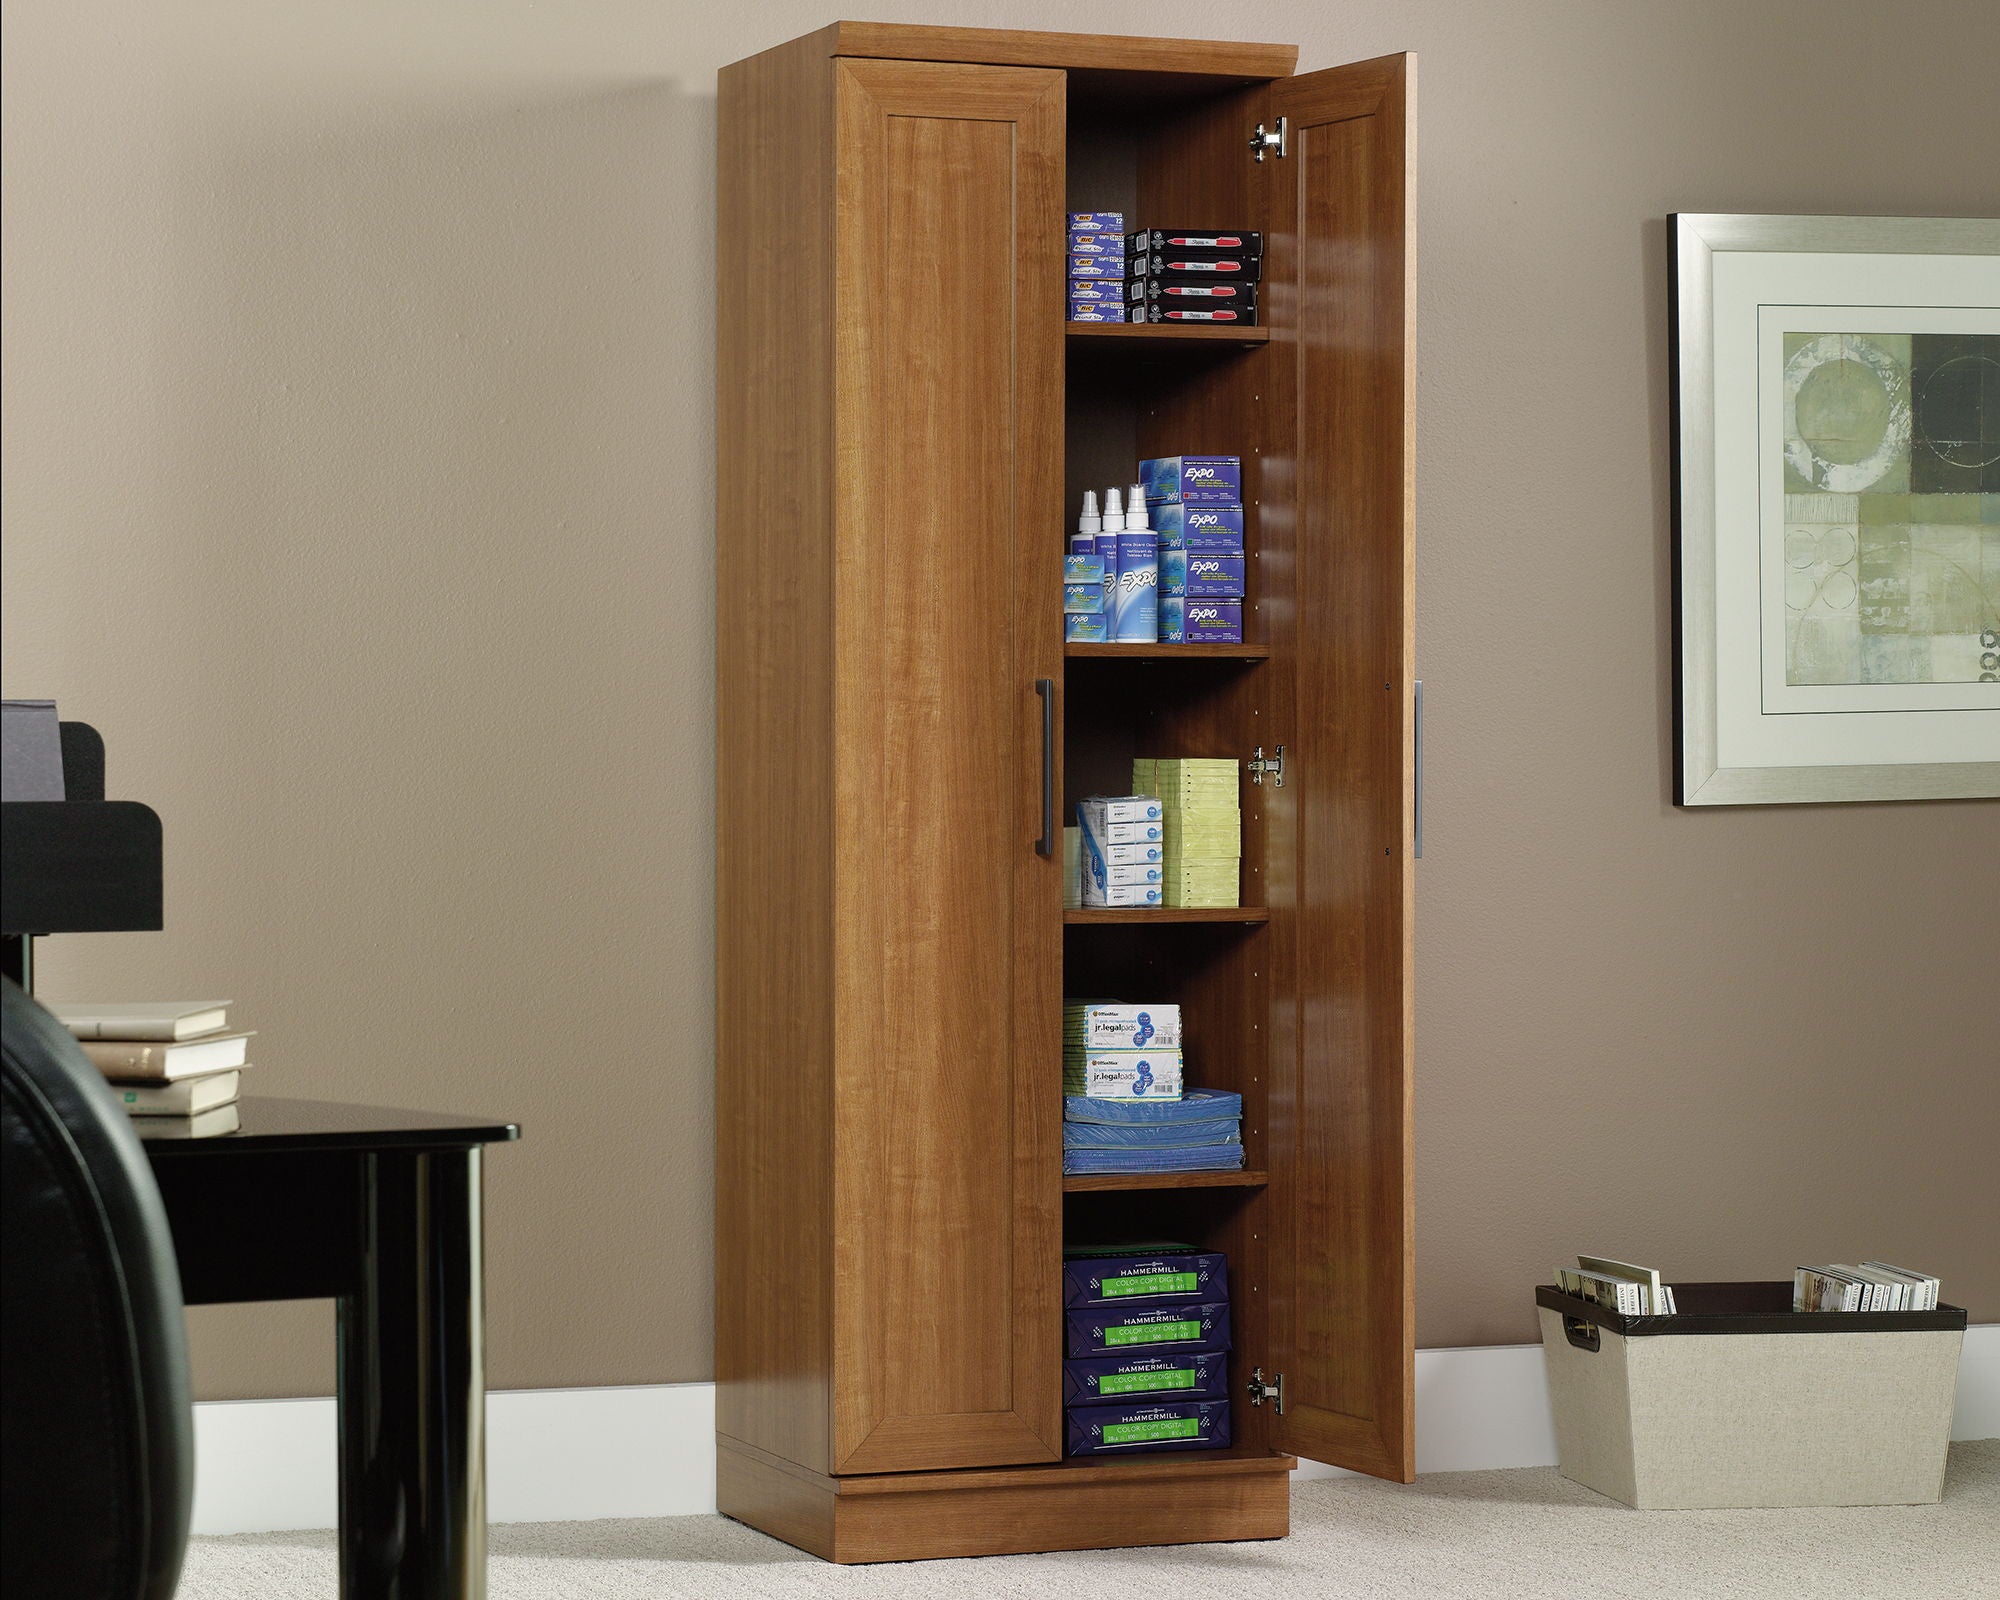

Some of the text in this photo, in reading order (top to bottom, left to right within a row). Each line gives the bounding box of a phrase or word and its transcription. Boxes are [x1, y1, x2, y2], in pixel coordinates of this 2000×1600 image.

[1184, 467, 1214, 481] EXPO
[1188, 514, 1218, 528] EXPO
[1190, 561, 1219, 575] EXPO
[1119, 571, 1157, 592] EXPO
[1188, 608, 1218, 622] EXPO
[1120, 1266, 1179, 1276] HAMMERMILL
[1115, 1275, 1184, 1287] COLOR COPY DIGIAL
[1124, 1315, 1183, 1325] HAMMERMILL
[1119, 1324, 1187, 1336] COLOR COPY DIGIAL
[1118, 1363, 1177, 1373] HAMMERMILL
[1113, 1372, 1182, 1384] COLOR COPY DIGITAL
[1122, 1413, 1181, 1423] HAMMERMILL
[1117, 1425, 1140, 1433] COLOR
[1161, 1422, 1184, 1430] DIGITAL
